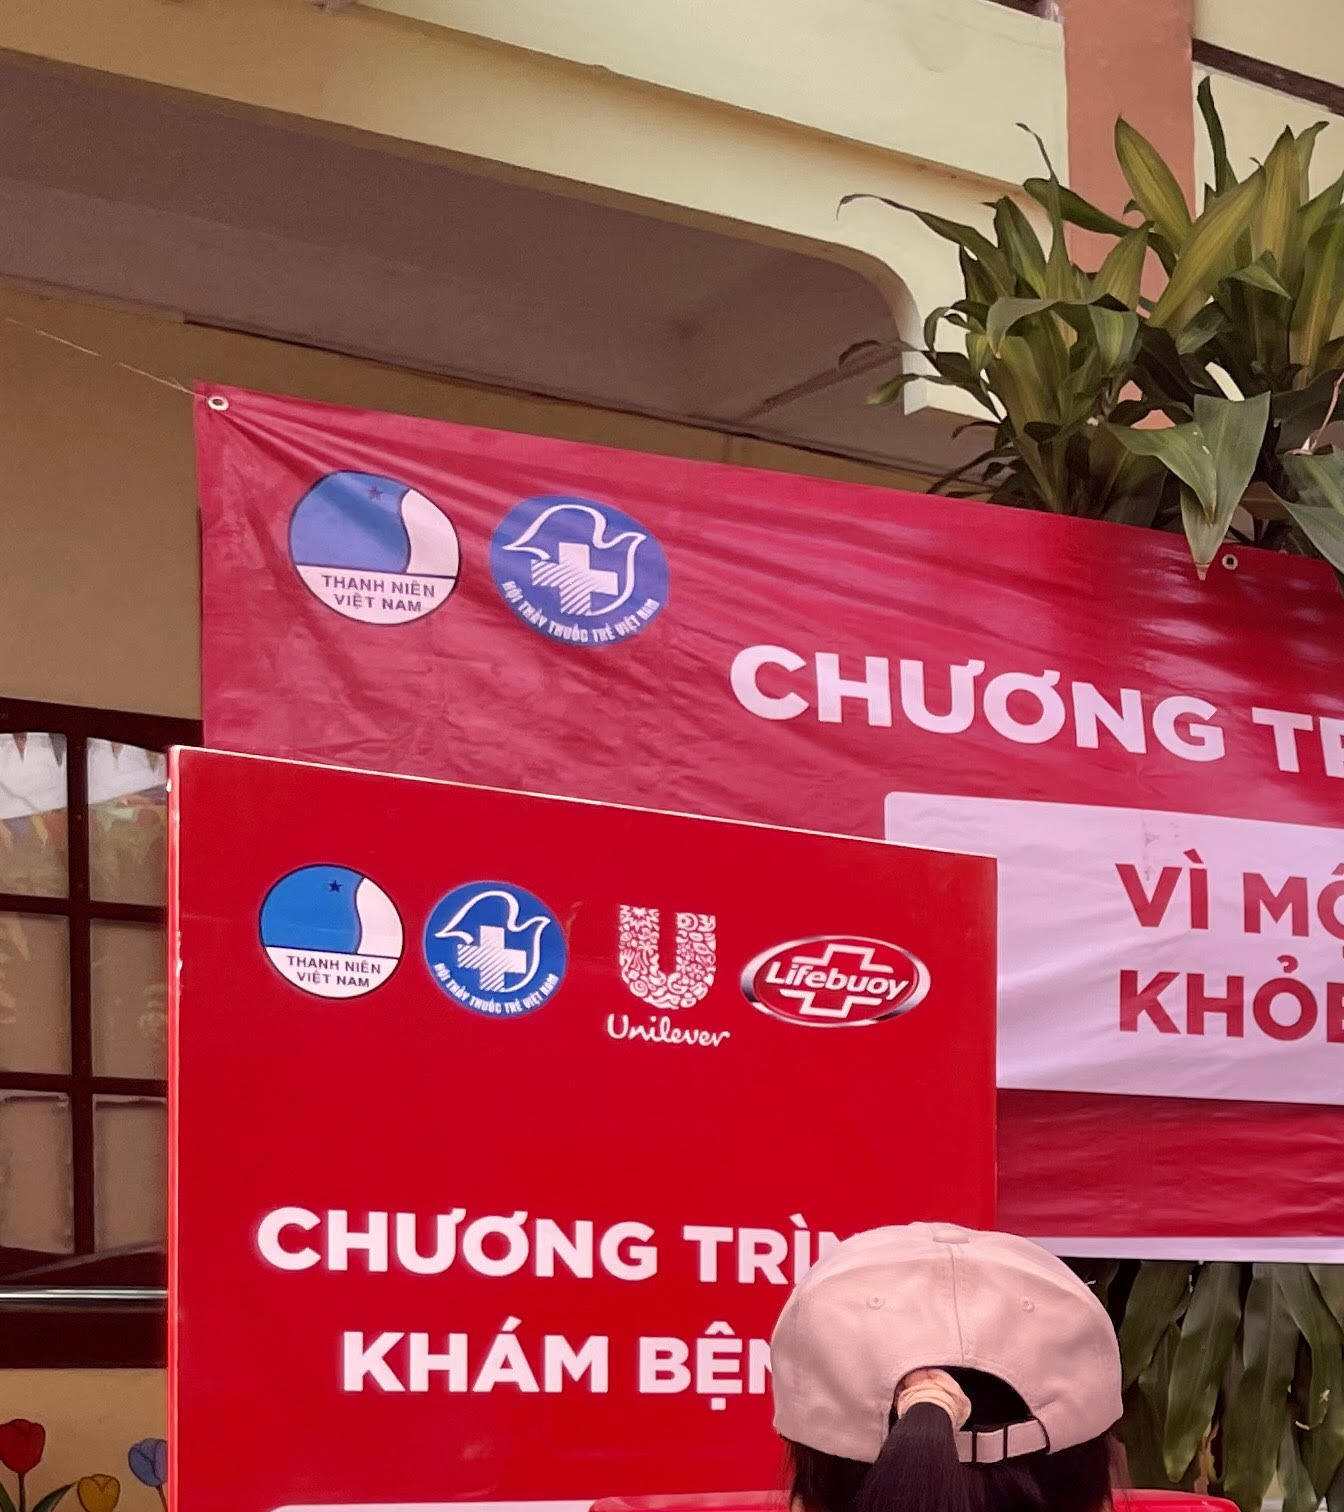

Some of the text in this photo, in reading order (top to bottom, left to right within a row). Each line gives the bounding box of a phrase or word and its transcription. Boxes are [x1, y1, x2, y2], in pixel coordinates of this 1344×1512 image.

[321, 574, 435, 598] THANH NIÊN
[333, 592, 422, 612] VIỆT NAM
[729, 644, 1227, 762] CHƯƠNG
[1115, 849, 1210, 931] VÌ
[286, 955, 381, 975] THANH NIÊN
[296, 969, 370, 988] VIỆT NAM
[765, 960, 910, 1001] Lifebuoy
[606, 1012, 731, 1047] Unilever
[257, 1205, 845, 1285] CHƯƠNG TRÌ
[341, 1315, 773, 1411] KHÁM BỆ
